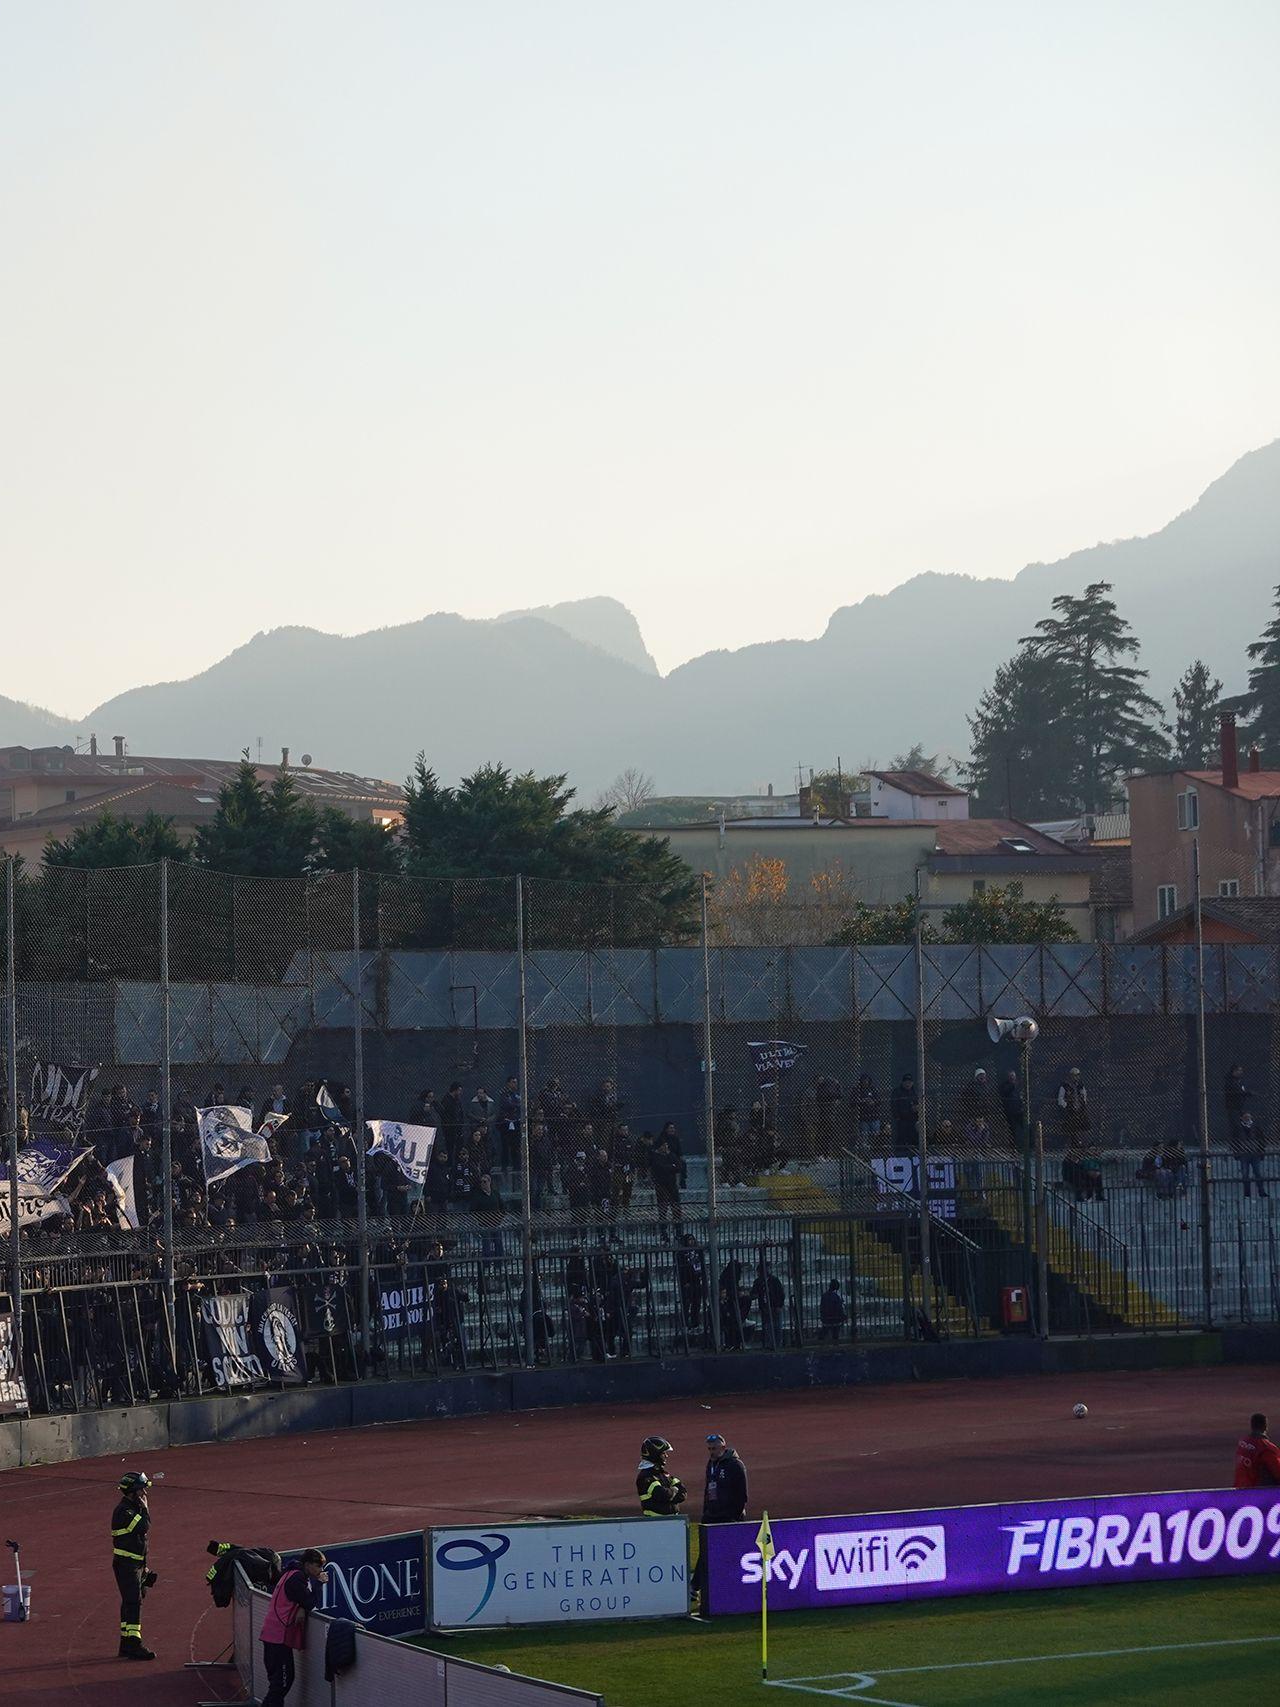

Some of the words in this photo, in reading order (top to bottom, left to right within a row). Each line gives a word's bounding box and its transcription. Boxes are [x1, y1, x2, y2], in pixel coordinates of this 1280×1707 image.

[405, 1307, 434, 1325] NOD
[552, 1542, 637, 1564] THIRD
[740, 1548, 810, 1590] sky
[824, 1535, 889, 1576] wifi
[503, 1565, 685, 1592] GENERATION
[378, 1606, 422, 1622] EXPERIENCE
[559, 1596, 632, 1613] GROUP
